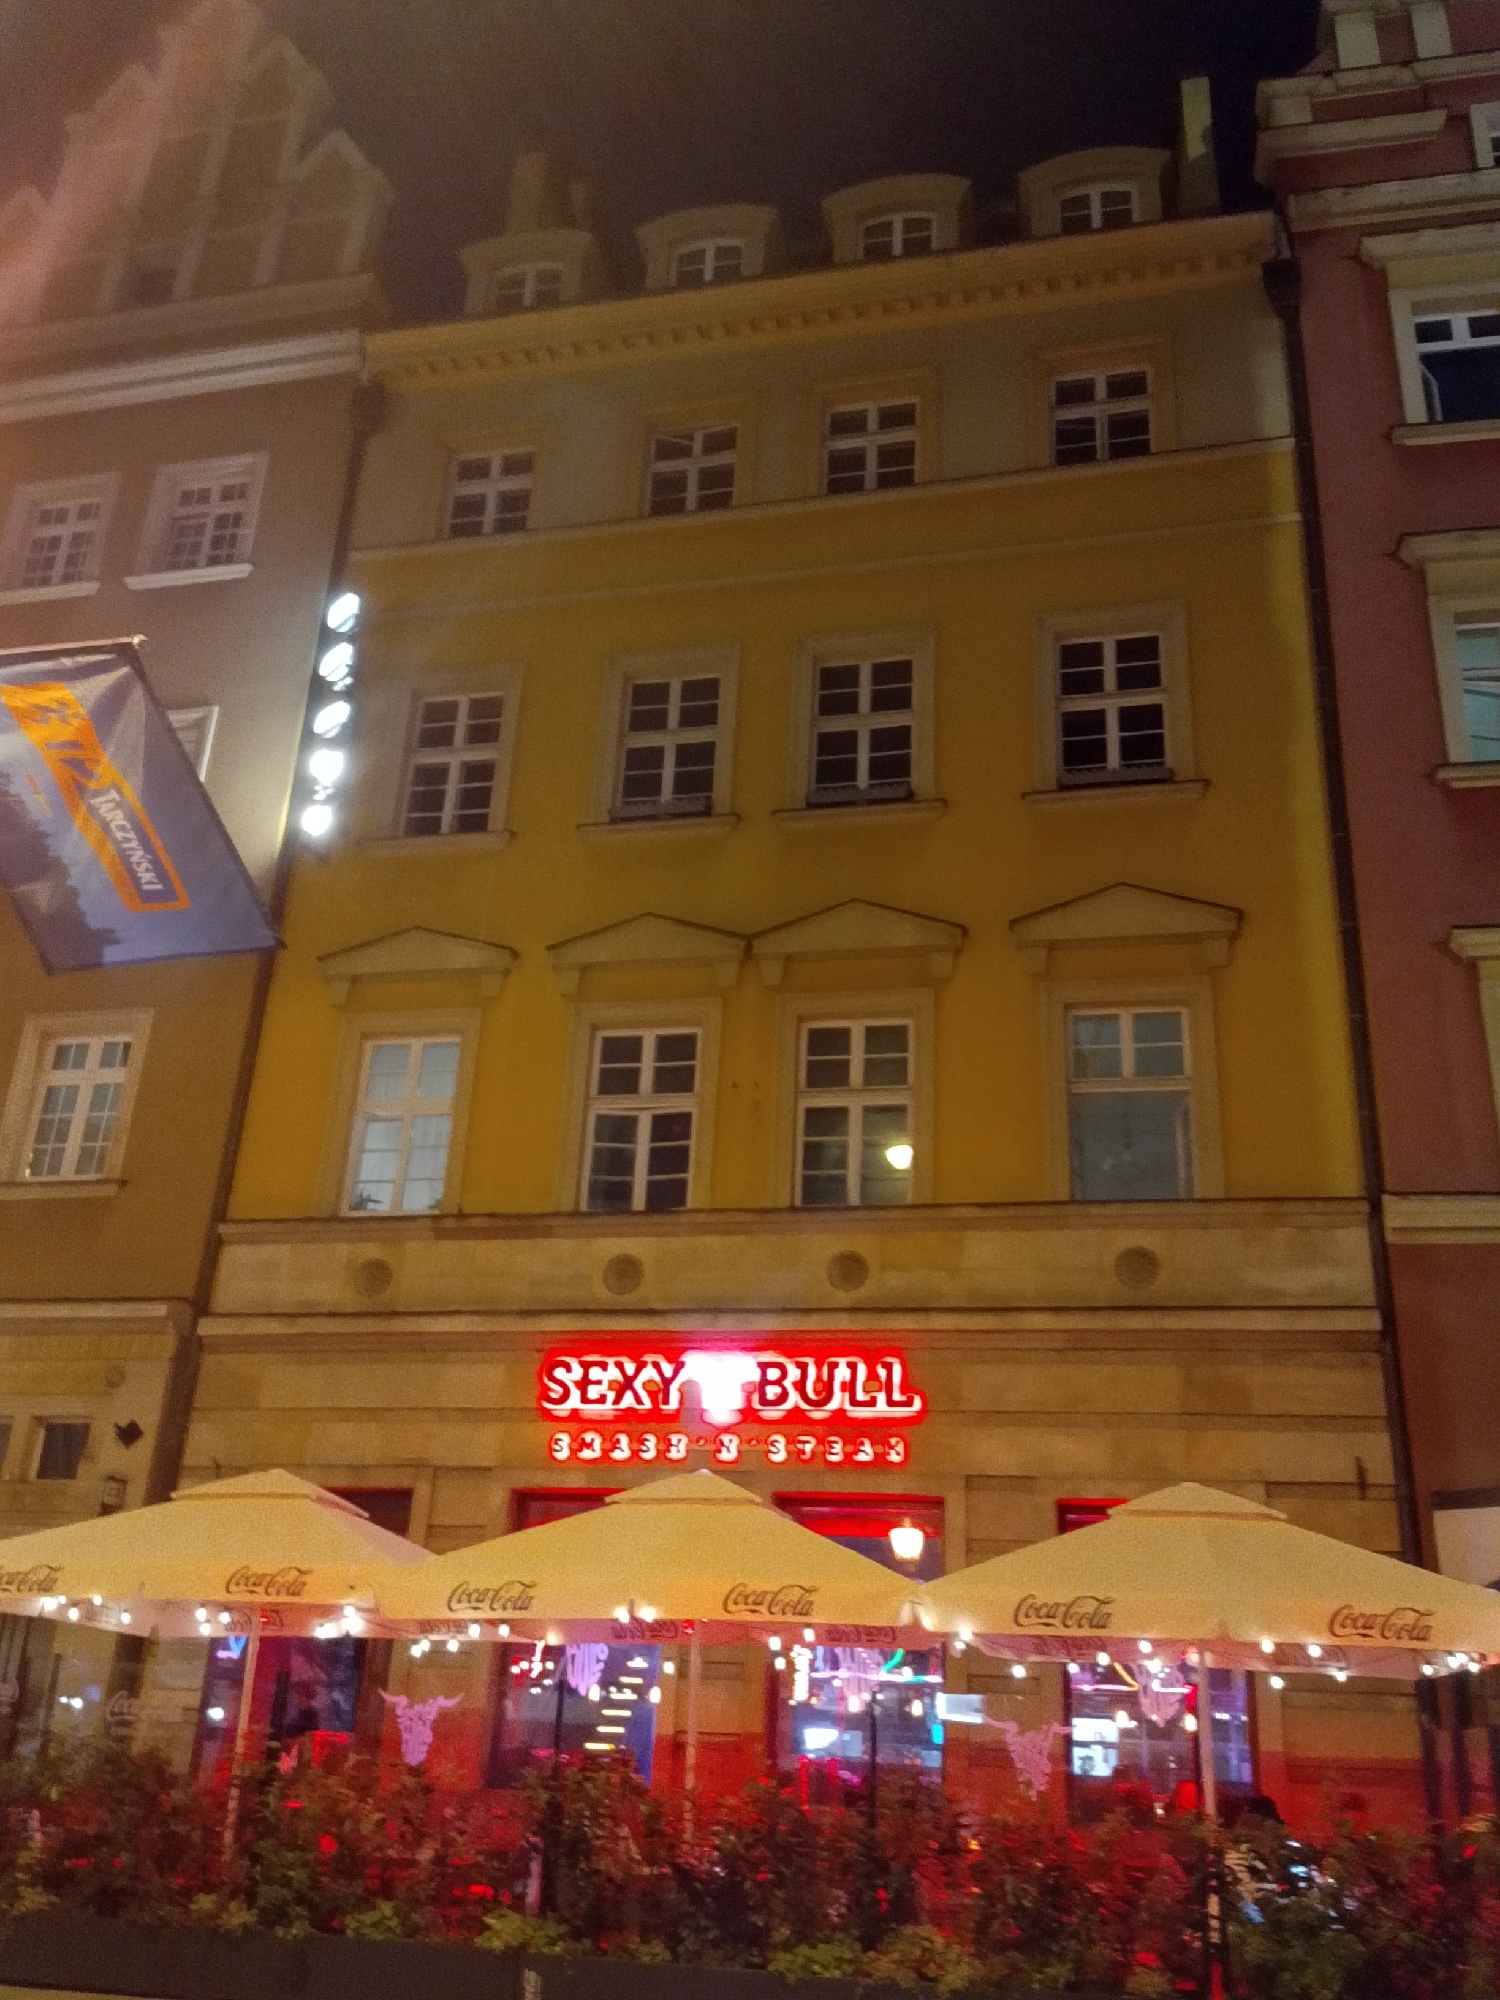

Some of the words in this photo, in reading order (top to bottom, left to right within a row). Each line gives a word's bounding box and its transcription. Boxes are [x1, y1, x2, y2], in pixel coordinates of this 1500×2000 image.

[541, 1357, 687, 1409] SEXY
[756, 1357, 919, 1411] BULL
[551, 1433, 688, 1460] SMASH
[767, 1434, 904, 1462] STEAK
